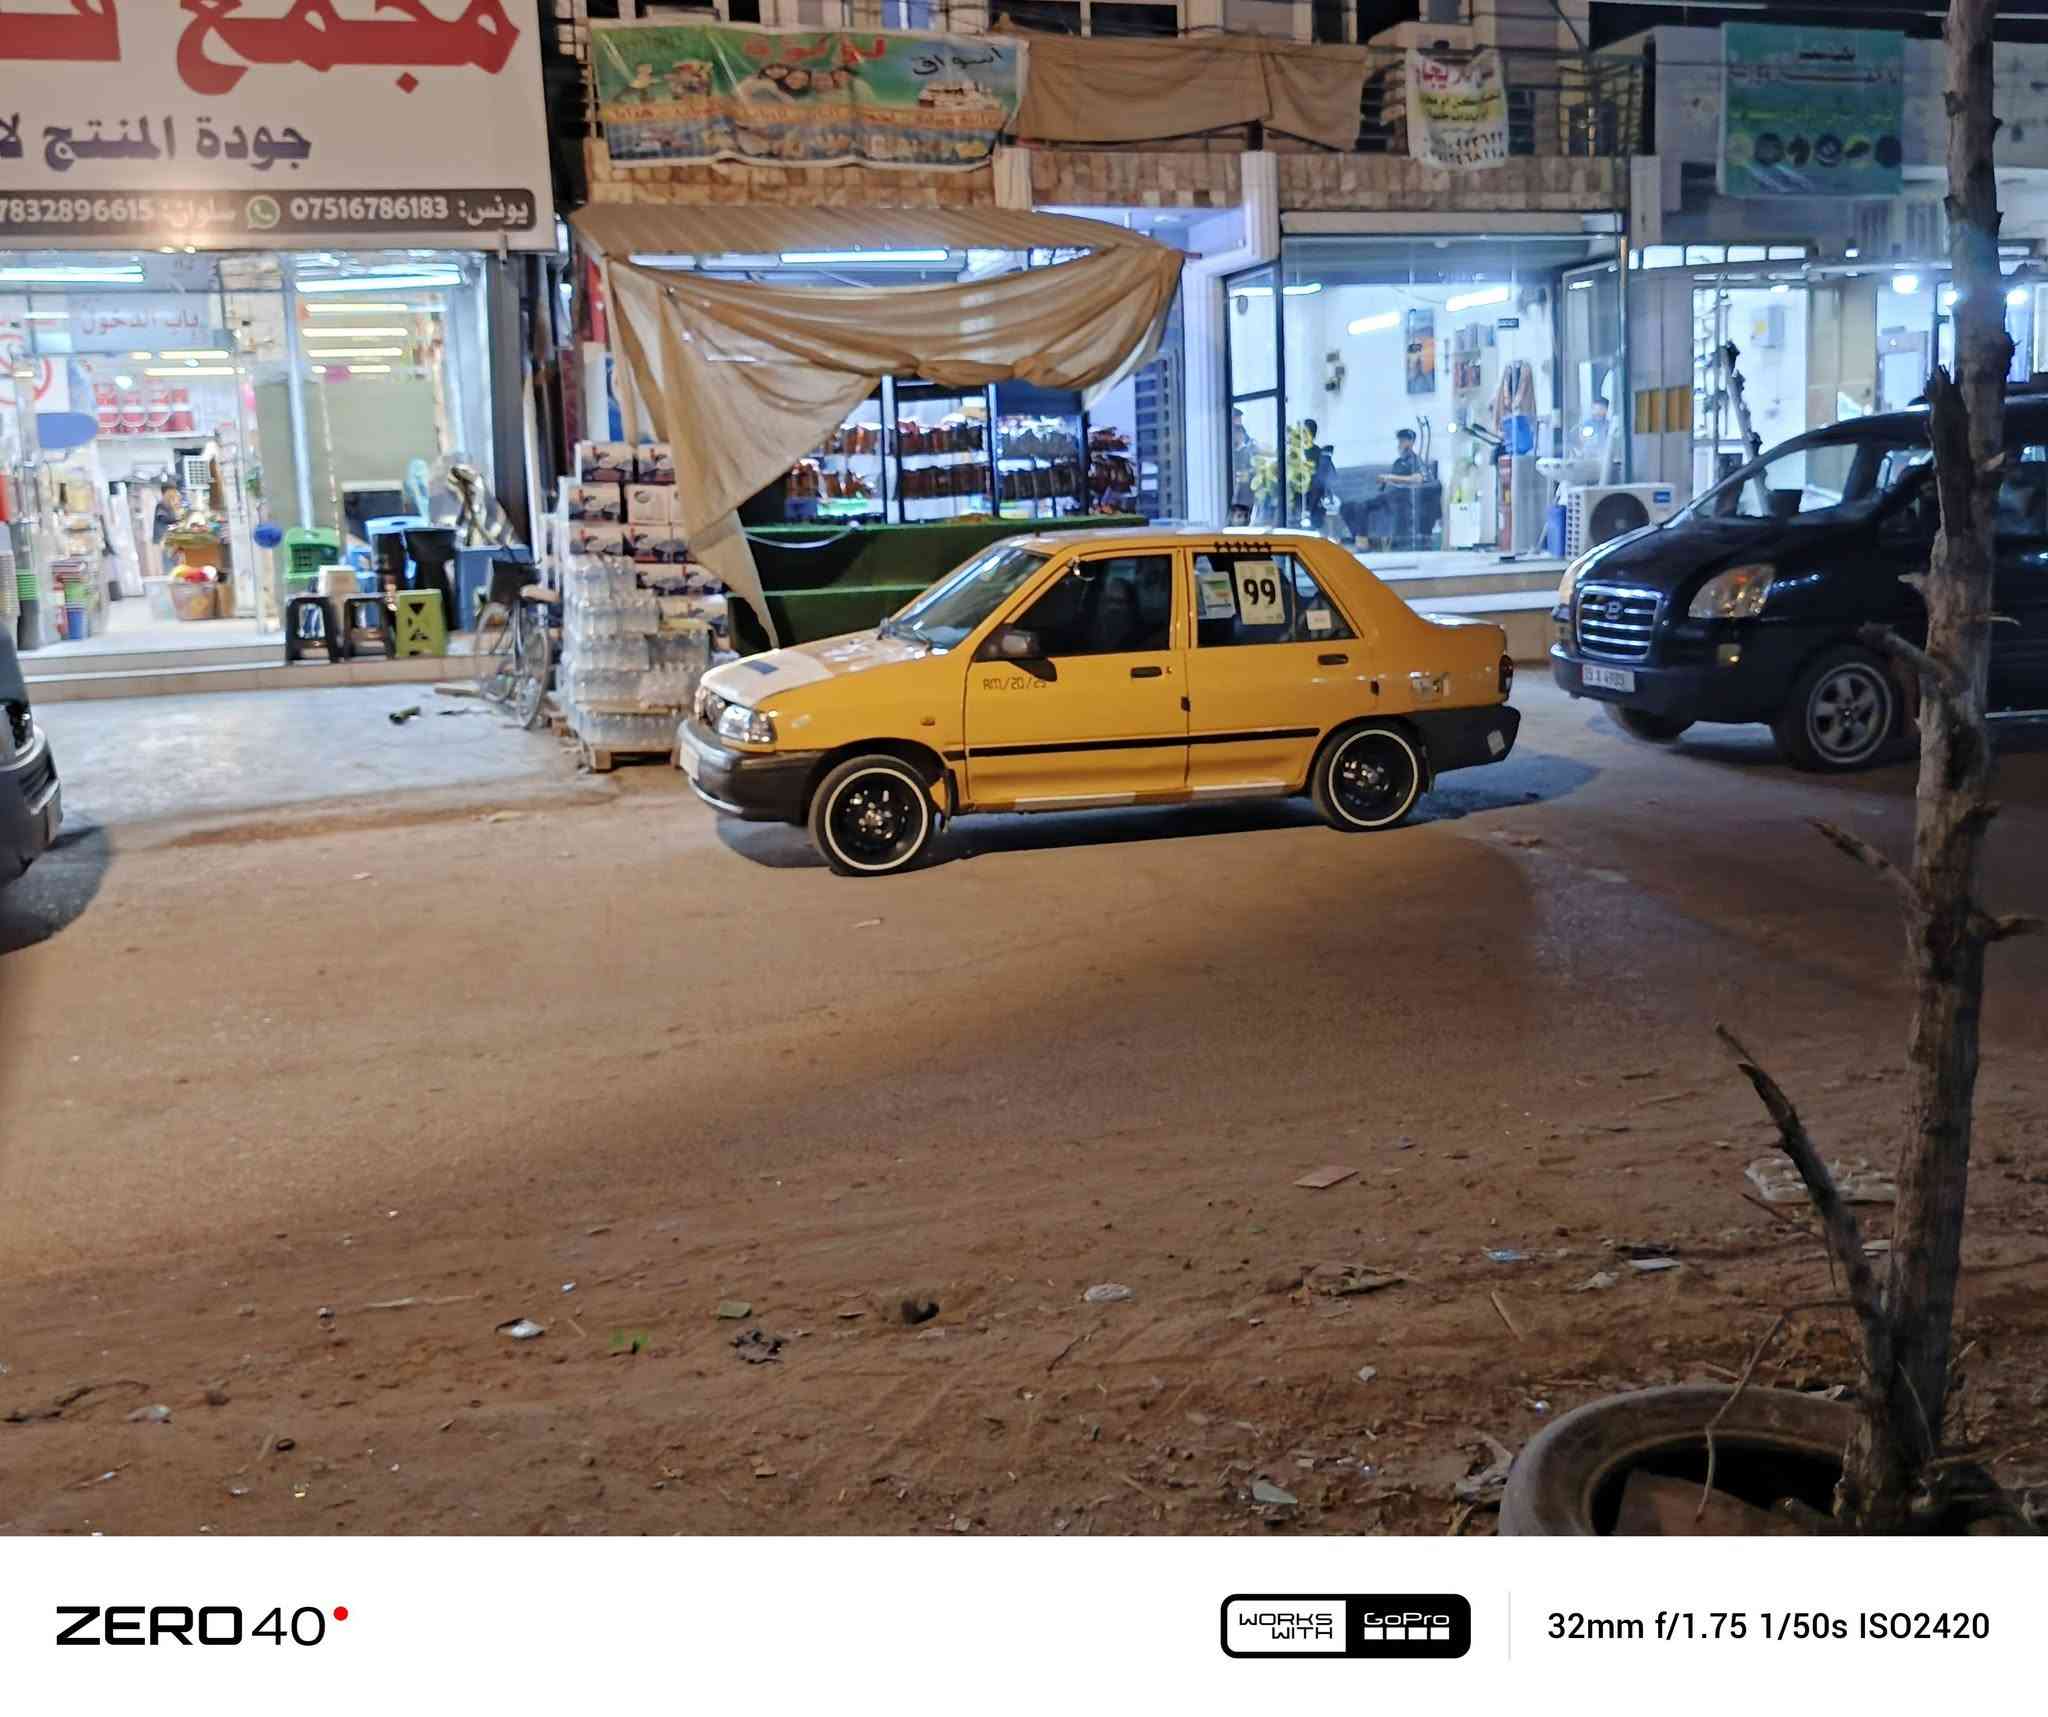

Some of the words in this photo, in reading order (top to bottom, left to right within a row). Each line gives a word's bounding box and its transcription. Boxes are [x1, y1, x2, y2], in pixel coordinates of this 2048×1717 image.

[43, 115, 176, 172] المنتج
[196, 115, 312, 170] جودة
[290, 195, 449, 221] 07516786183
[1243, 578, 1276, 605] 99
